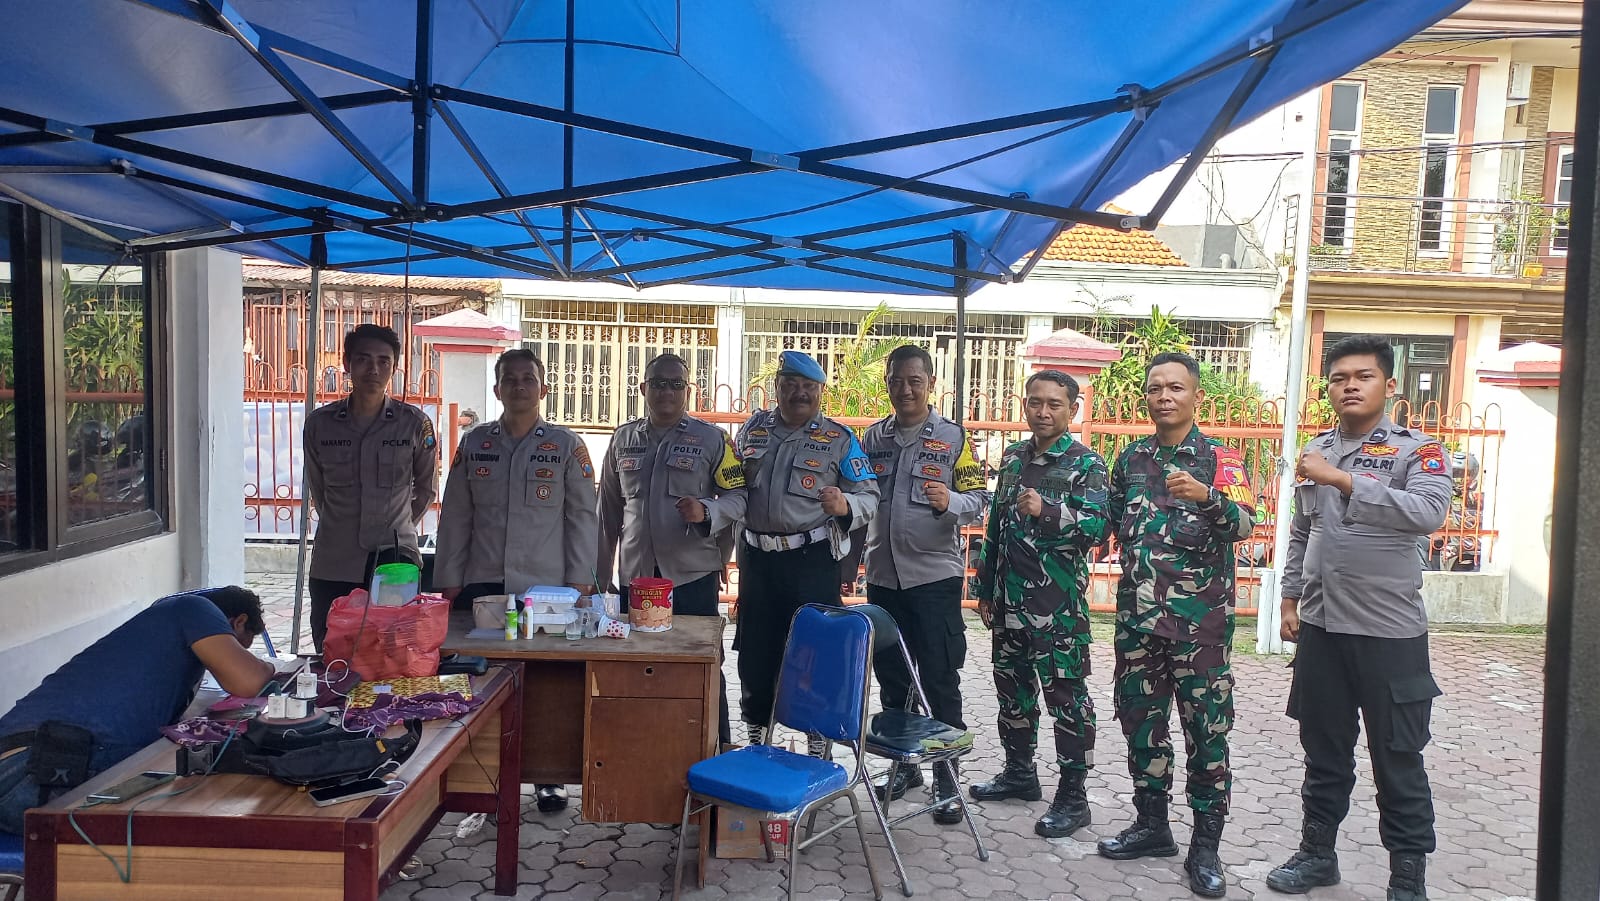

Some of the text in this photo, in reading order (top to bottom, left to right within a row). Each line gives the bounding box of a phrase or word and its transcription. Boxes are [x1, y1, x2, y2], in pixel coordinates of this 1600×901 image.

[673, 441, 703, 455] POLRI
[804, 442, 831, 452] POLRI
[530, 454, 561, 463] POLRI
[917, 451, 950, 463] POLRI
[1352, 457, 1395, 470] POLRI
[767, 823, 782, 833] 48
